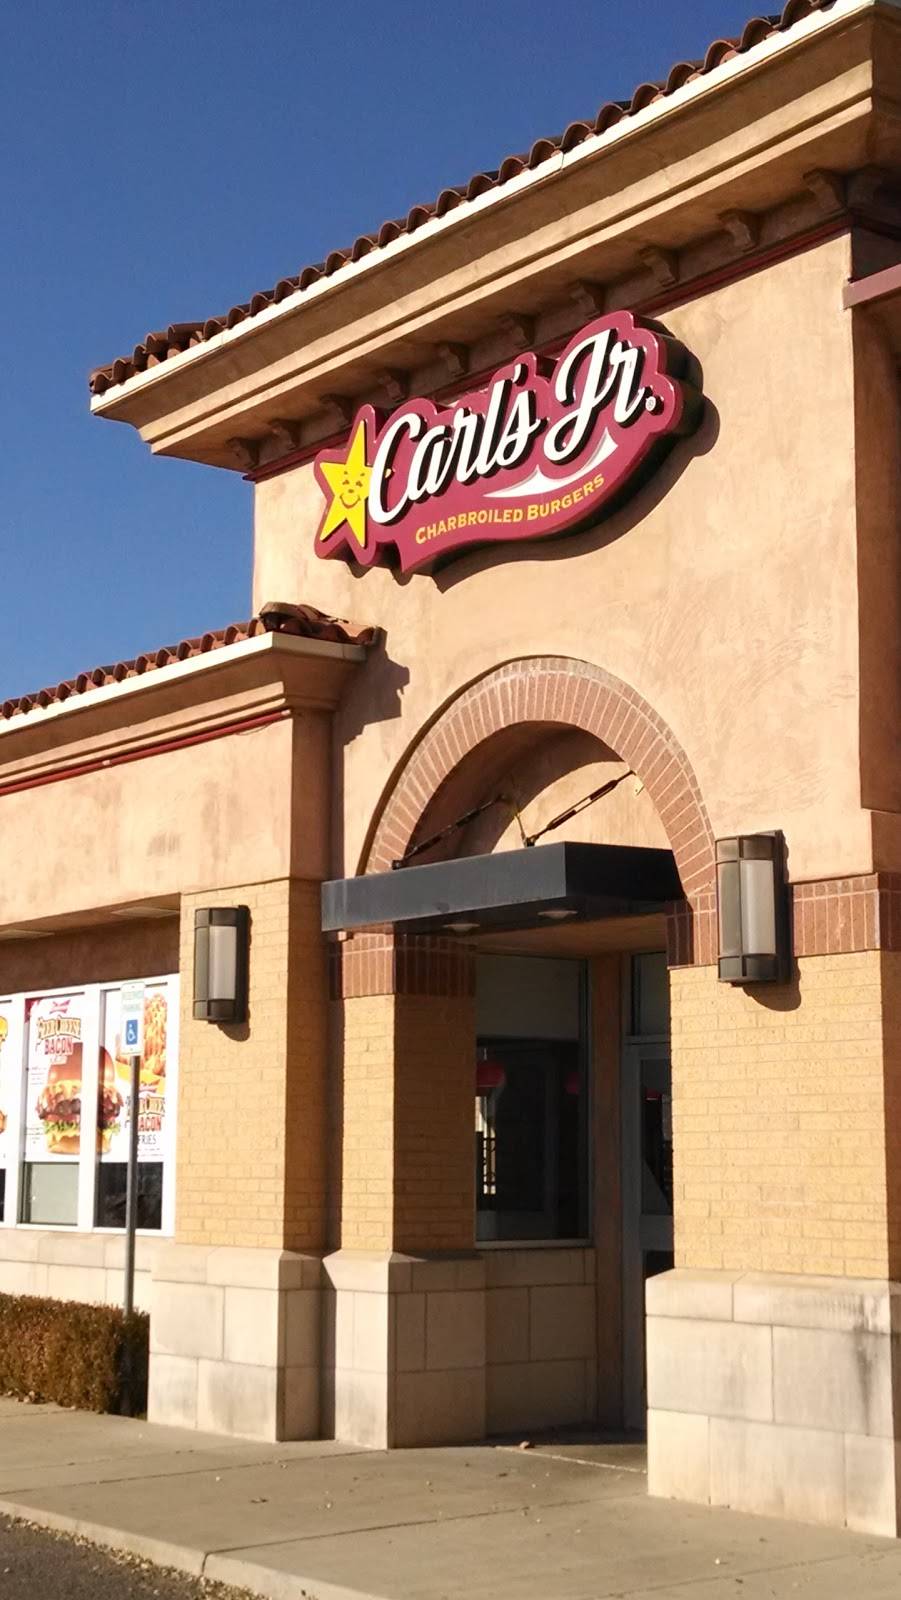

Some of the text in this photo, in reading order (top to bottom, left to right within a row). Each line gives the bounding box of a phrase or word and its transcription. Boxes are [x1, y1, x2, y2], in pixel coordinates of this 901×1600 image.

[369, 363, 541, 524] Carl's
[415, 473, 605, 545] CHARBROILED BURGERS
[44, 1037, 74, 1056] BACON
[138, 1116, 162, 1132] ACON
